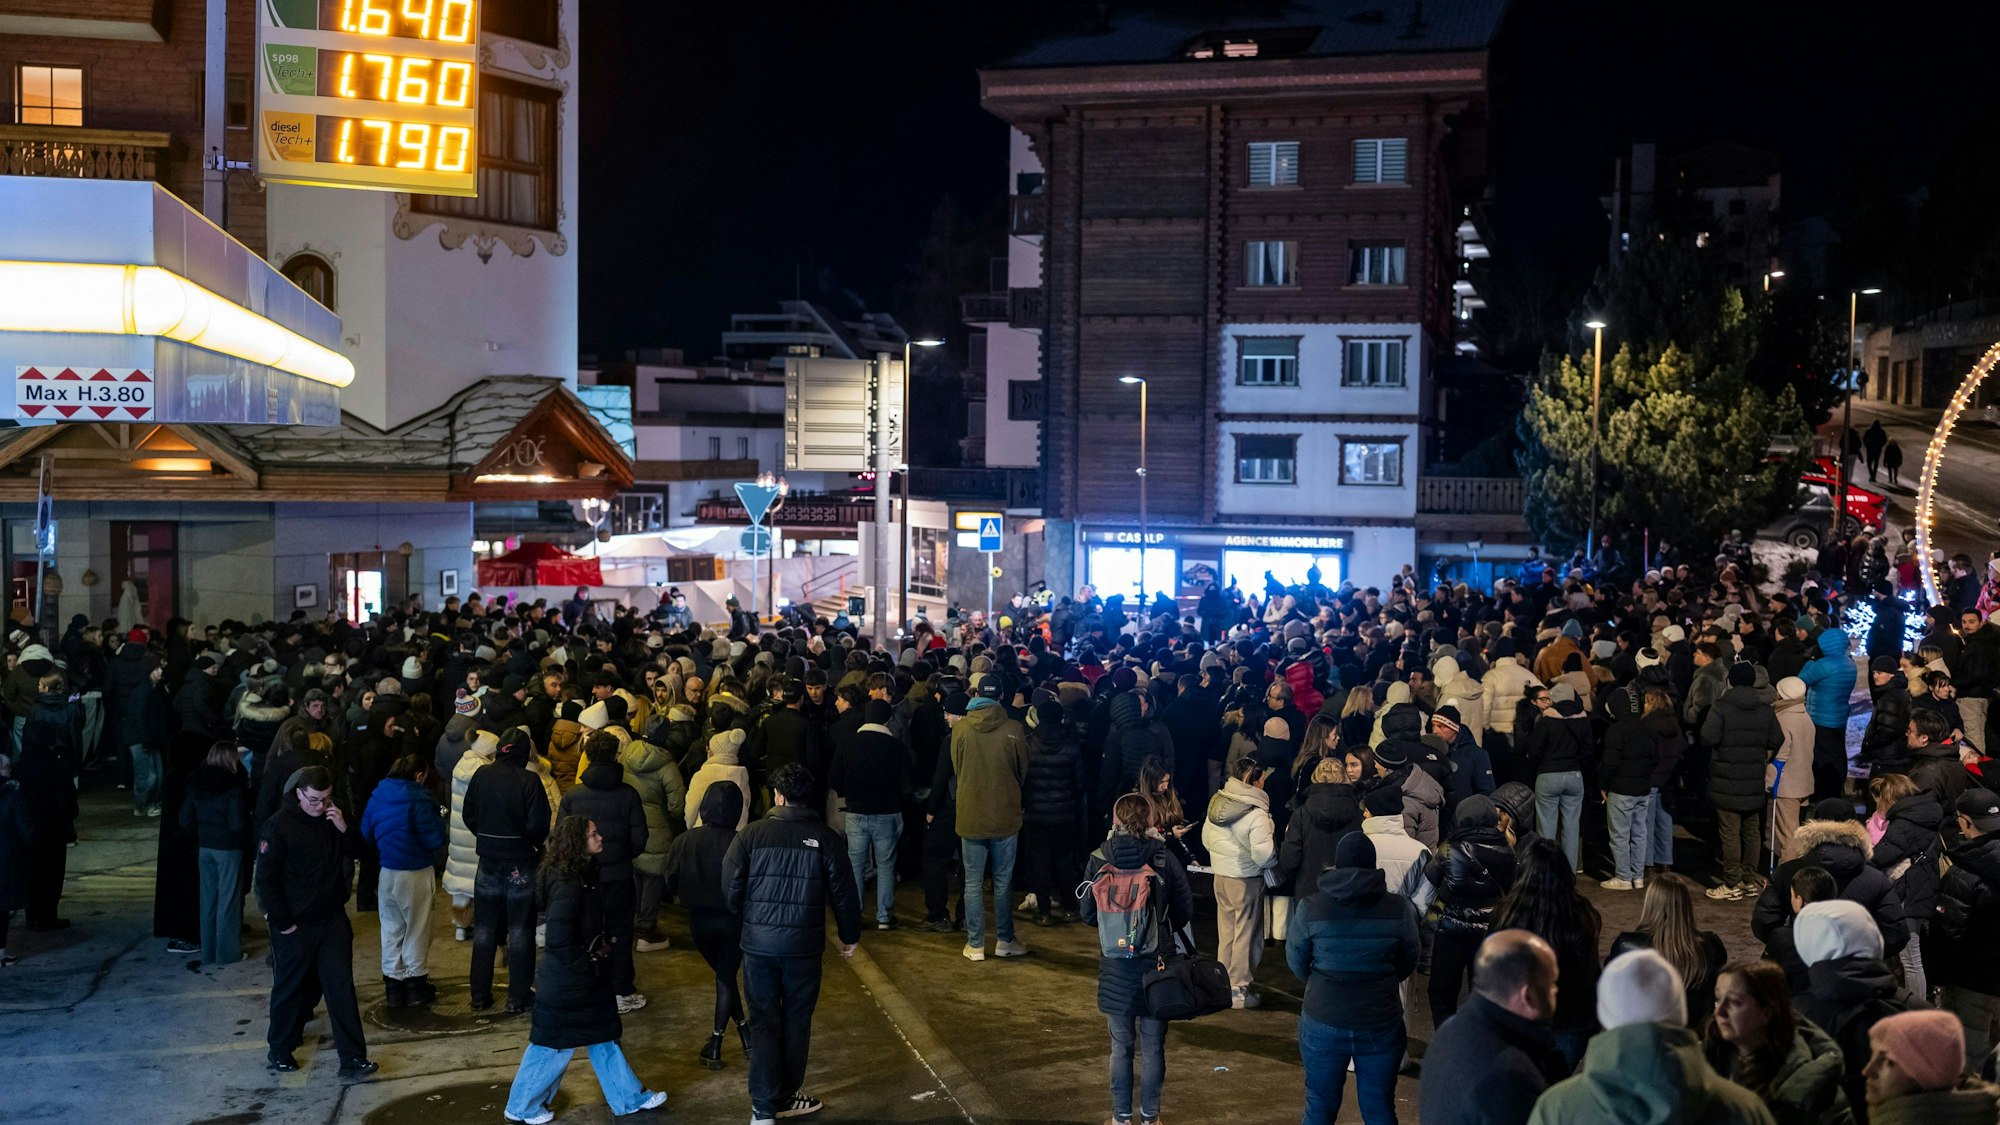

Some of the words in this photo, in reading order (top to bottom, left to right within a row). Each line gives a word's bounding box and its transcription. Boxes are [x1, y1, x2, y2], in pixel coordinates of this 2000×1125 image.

[341, 0, 474, 42] 1.640
[272, 53, 299, 63] sp98
[277, 65, 315, 78] Tech+
[339, 53, 471, 107] 1.760
[270, 121, 301, 133] diesel
[274, 132, 313, 146] Tech+
[338, 119, 470, 172] 1.790
[26, 384, 68, 401] Max
[78, 385, 145, 402] H.3.80
[1225, 536, 1269, 546] AGENCE
[1270, 537, 1344, 548] IMMOBILIERE
